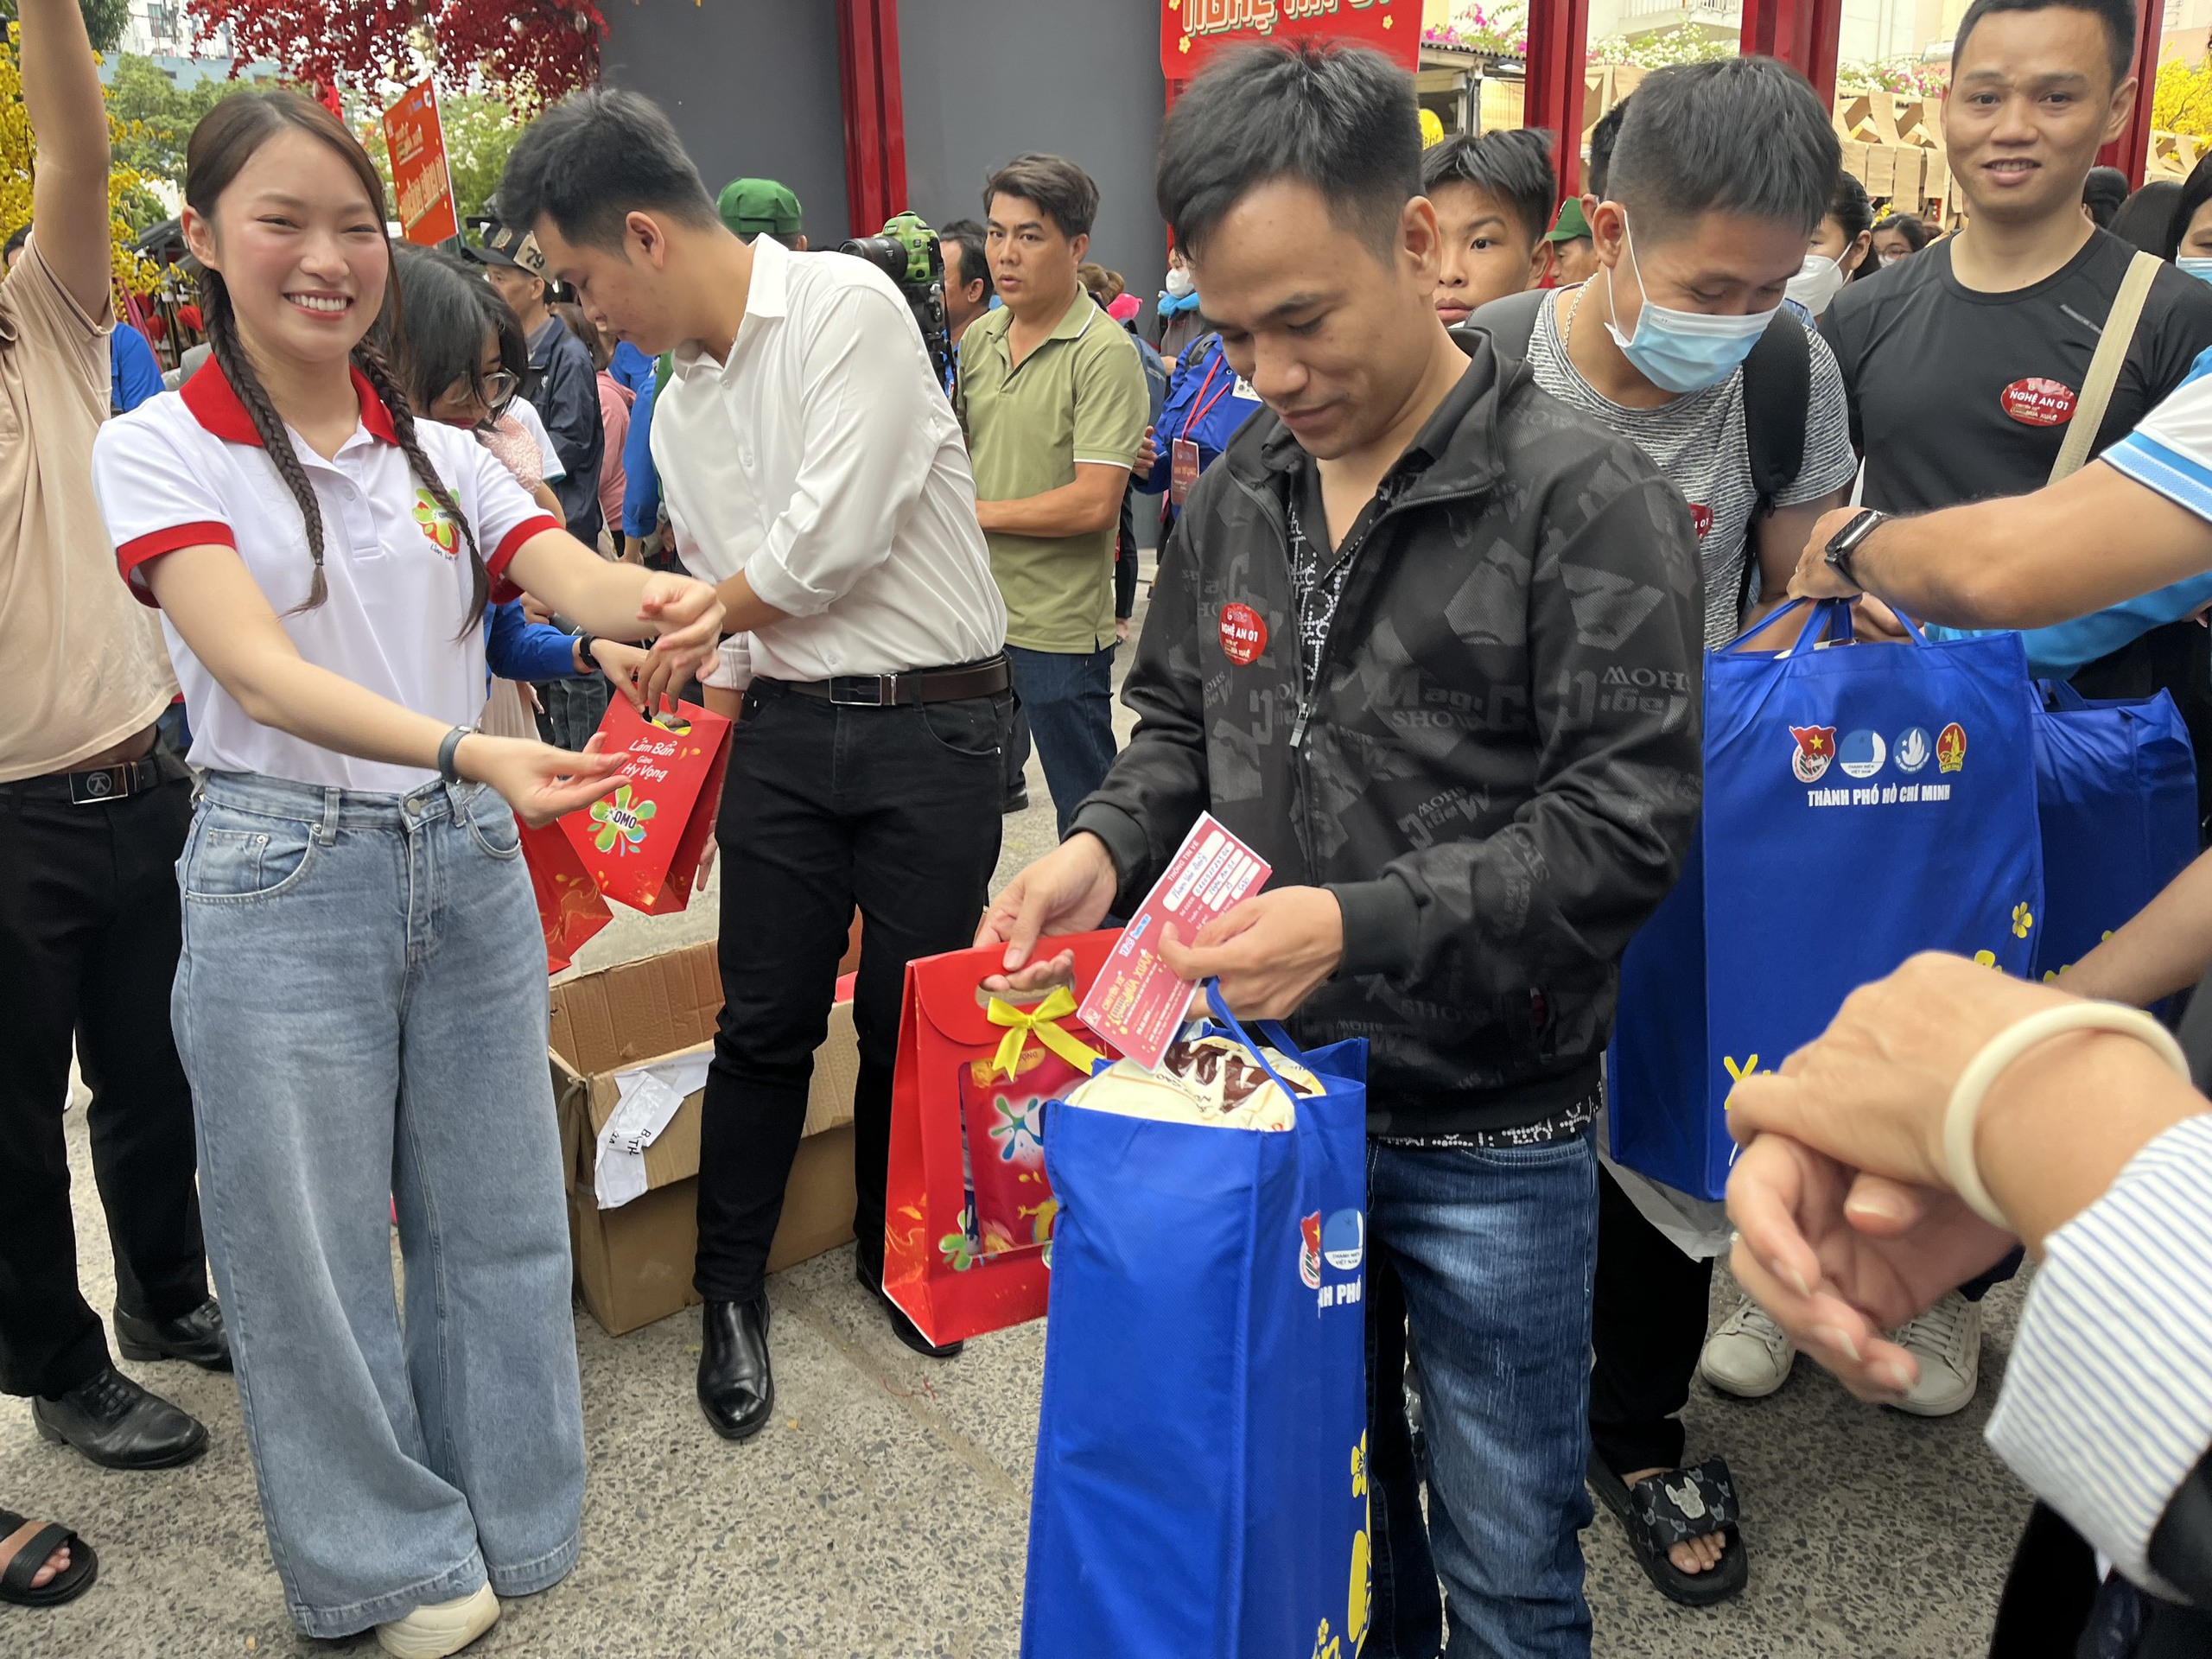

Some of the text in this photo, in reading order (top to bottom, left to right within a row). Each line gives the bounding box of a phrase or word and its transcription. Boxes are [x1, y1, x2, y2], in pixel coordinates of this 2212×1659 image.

[526, 246, 546, 270] 79
[2009, 390, 2069, 410] NGHỆ AN 01
[1700, 518, 1709, 528] 01
[1236, 627, 1247, 639] AN
[1248, 630, 1259, 643] 01
[629, 737, 678, 757] Lấm Bẩn
[636, 754, 653, 765] Gieo
[621, 761, 669, 784] Hy Vọng
[1808, 783, 1951, 807] THÀNH PHỐ HỒ CHÍ MINH
[613, 809, 638, 830] OMO
[1167, 860, 1185, 882] THÔNG
[1184, 849, 1194, 861] TIN
[1336, 1274, 1362, 1306] PHỐ
